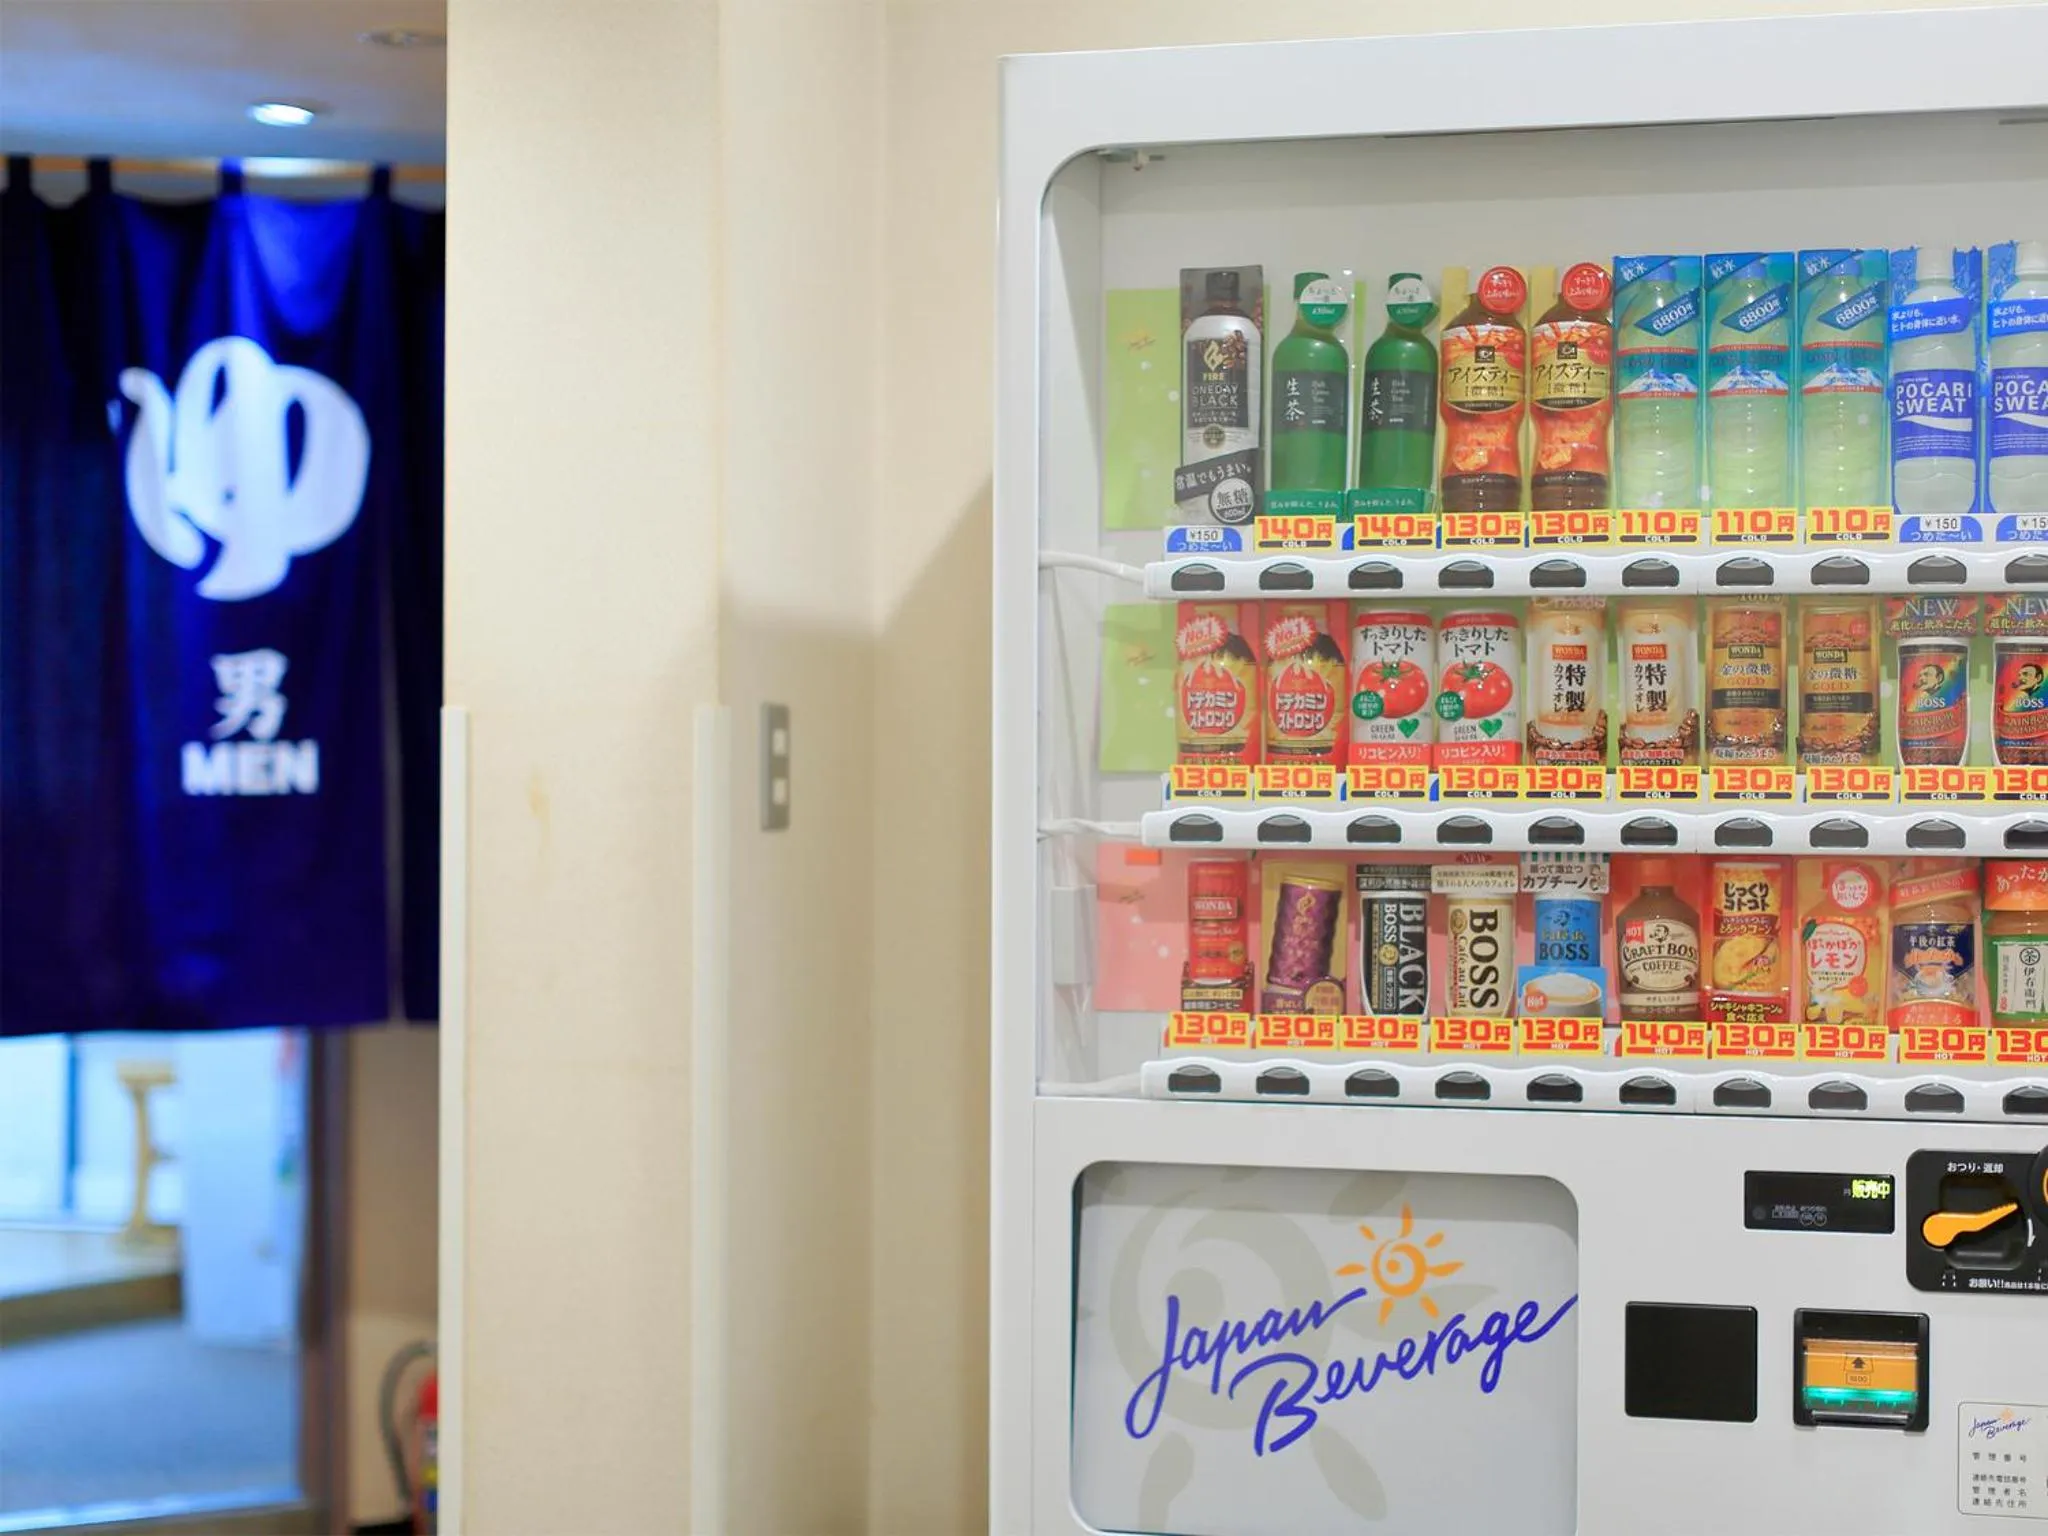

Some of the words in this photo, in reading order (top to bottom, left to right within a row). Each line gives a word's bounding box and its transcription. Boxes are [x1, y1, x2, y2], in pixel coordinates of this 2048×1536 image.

[1448, 366, 1520, 383] アイスティー
[1535, 362, 1605, 381] アイスティー
[1895, 380, 1972, 401] POCARI
[1994, 378, 2048, 398] POCA
[1896, 398, 1967, 416] SWEAT
[1994, 398, 2048, 414] SWEA
[116, 334, 372, 601] ゆ
[1257, 517, 1332, 539] 140円
[1356, 515, 1433, 538] 140円
[1445, 514, 1521, 536] 130円
[1531, 512, 1609, 535] 130円
[1621, 511, 1698, 534] 110円
[1716, 510, 1795, 533] 110円
[1812, 508, 1890, 532] 110円
[1923, 518, 1958, 530] ¥150
[1281, 540, 1307, 548] COLD
[1741, 534, 1767, 542] COLD
[1904, 599, 1958, 616] NEW
[1360, 626, 1427, 642] すっきりした
[1442, 626, 1509, 642] すっきりした
[1373, 642, 1414, 656] トマト
[1454, 642, 1495, 657] トマト
[1730, 646, 1762, 654] WONDA
[1814, 650, 1846, 660] WONDA
[208, 647, 289, 741] 男
[1553, 663, 1564, 713] カフェオレ
[1565, 663, 1586, 712] 特製
[1635, 663, 1645, 713] カフェオレ
[1645, 663, 1667, 712] 特製
[1187, 691, 1237, 710] ドデカミン
[1275, 691, 1327, 711] ドデカミン
[1917, 697, 1945, 708] BOSS
[2015, 697, 2044, 708] BOSS
[1189, 710, 1236, 729] ストロング
[1278, 711, 1325, 730] ストロング
[181, 739, 319, 795] MEN
[1173, 767, 1247, 788] 130円
[1259, 767, 1332, 788] 130円
[1350, 767, 1425, 789] 130円
[1443, 767, 1519, 789] 130円
[1526, 768, 1601, 790] 130円
[1620, 768, 1698, 790] 130円
[1714, 768, 1792, 790] 130円
[1811, 768, 1890, 790] 130円
[1904, 768, 1985, 791] 130円
[1523, 875, 1589, 889] カプチーノ
[1724, 881, 1770, 898] じっくり
[1193, 900, 1233, 910] WONDA
[1723, 898, 1771, 911] コトコト
[1384, 903, 1397, 943] BOSS
[1625, 926, 1642, 938] HOT
[1909, 935, 1956, 947] 午後の紅茶
[1399, 902, 1425, 1011] BLACK
[1469, 909, 1499, 1009] BOSS
[1539, 943, 1590, 961] BOSS
[1622, 944, 1665, 962] CRAFT
[1809, 955, 1858, 970] レモン
[1642, 959, 1682, 971] COFFEE
[1173, 1014, 1247, 1036] 130円
[1258, 1017, 1333, 1038] 130円
[1343, 1018, 1418, 1040] 130円
[1435, 1020, 1510, 1041] 130円
[1522, 1019, 1600, 1041] 130円
[1626, 1023, 1704, 1046] 140円
[1286, 1039, 1305, 1047] HOT
[1716, 1025, 1795, 1047] 130円
[1805, 1026, 1885, 1048] 130円
[1904, 1028, 1985, 1051] 130円
[1745, 1048, 1765, 1056] HOT
[1834, 1050, 1854, 1058] HOT
[1934, 1052, 1954, 1060] HOT
[1124, 1287, 1367, 1439] Japan
[1227, 1293, 1578, 1457] Beverage
